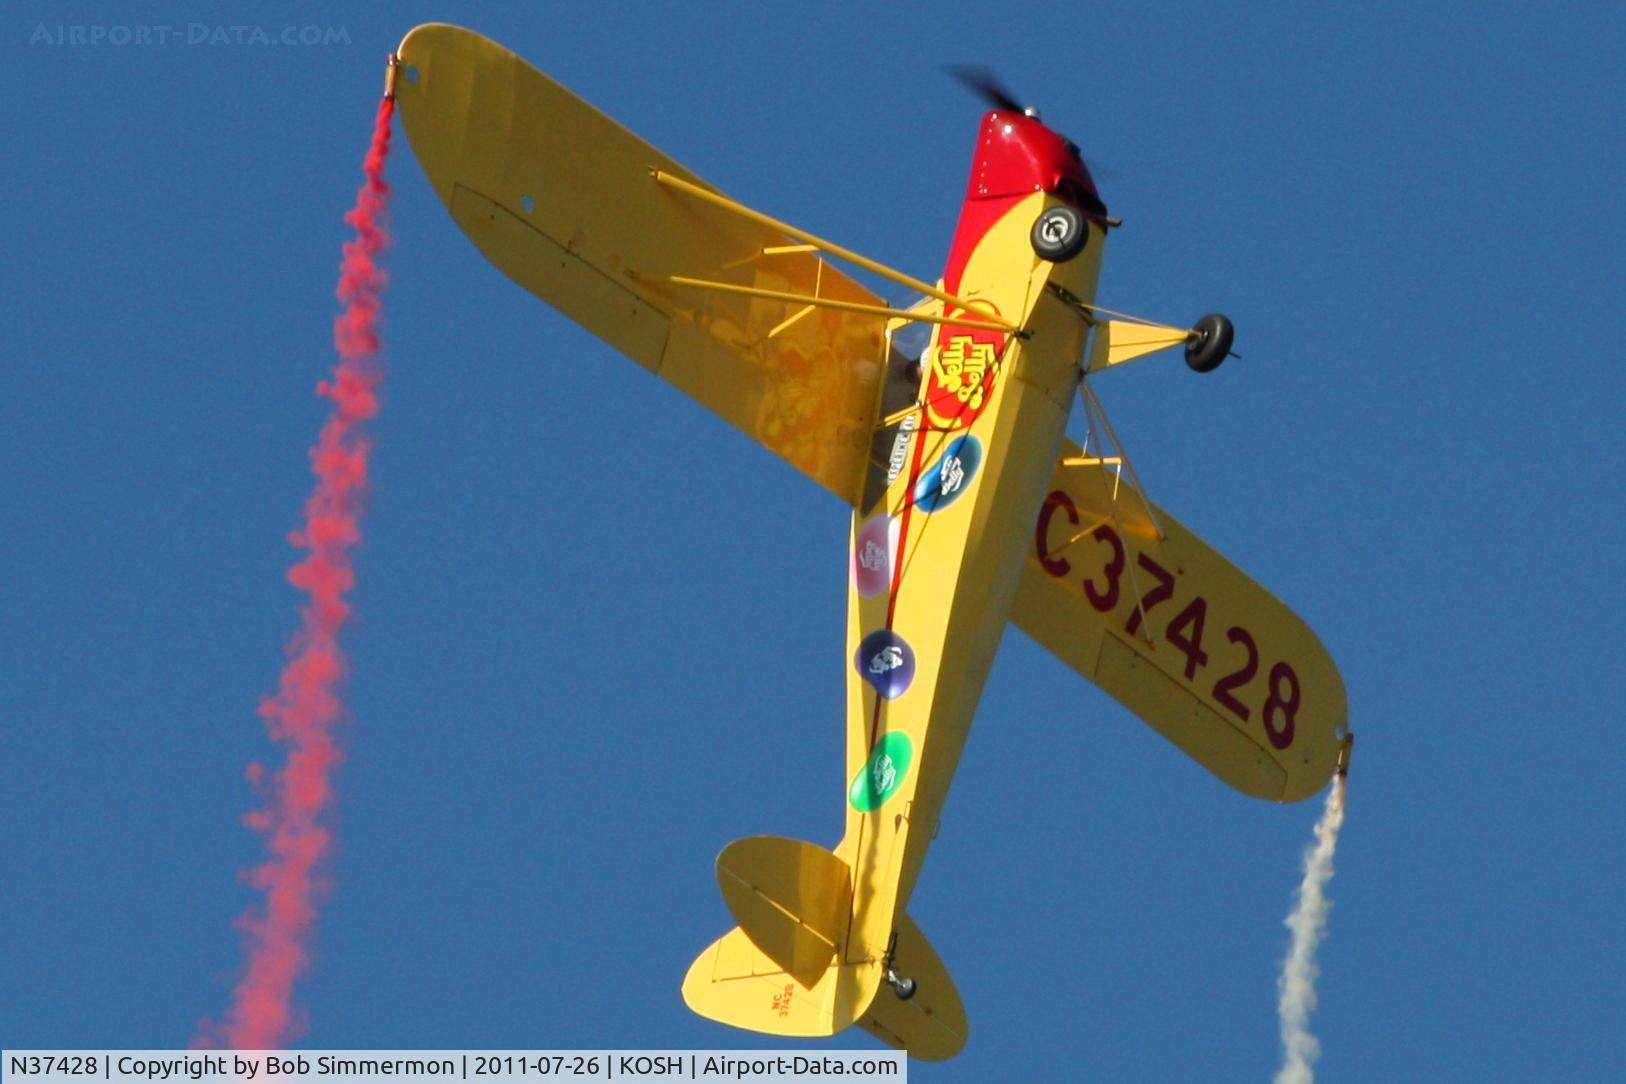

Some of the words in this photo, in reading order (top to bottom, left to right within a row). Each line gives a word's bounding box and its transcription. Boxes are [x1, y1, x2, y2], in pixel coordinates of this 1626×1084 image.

[932, 335, 973, 393] Jelly
[957, 342, 1000, 411] Belly
[771, 993, 782, 1010] NC
[779, 983, 794, 1018] 37428
